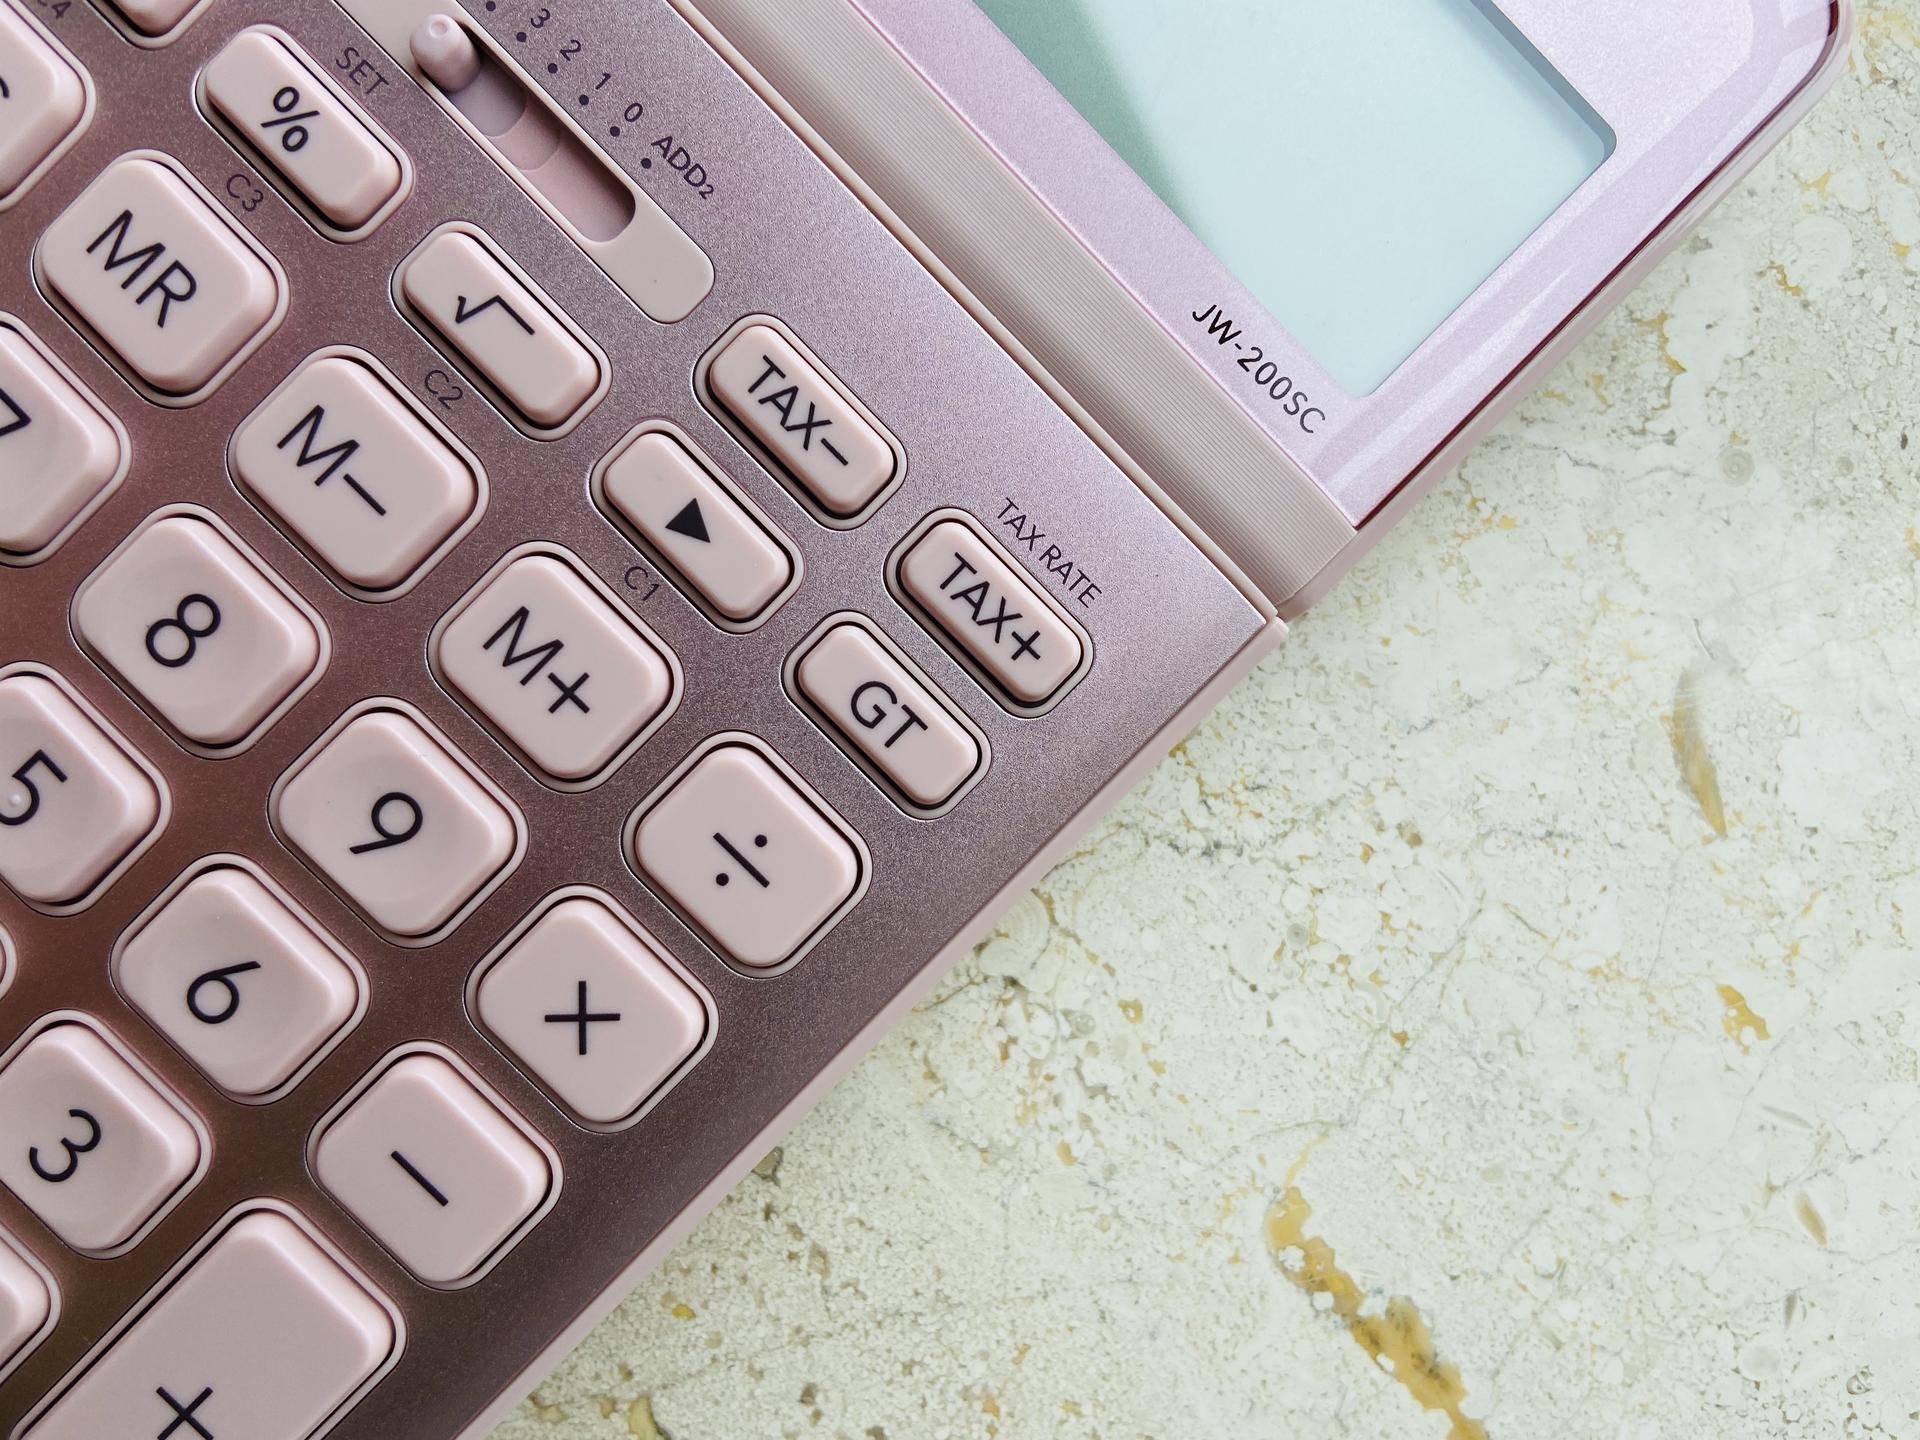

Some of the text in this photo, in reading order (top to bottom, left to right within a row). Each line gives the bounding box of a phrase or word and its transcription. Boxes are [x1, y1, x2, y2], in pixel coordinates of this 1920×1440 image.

[335, 47, 389, 95] SET
[530, 8, 551, 29] 3
[559, 39, 582, 61] 2
[595, 72, 612, 90] 1
[624, 102, 644, 123] 0
[260, 86, 320, 153] %
[226, 173, 264, 212] C3
[86, 209, 197, 329] MR
[424, 369, 464, 410] C2
[1192, 303, 1326, 434] JW-200SC
[624, 565, 660, 601] C1
[997, 497, 1103, 609] TAX RATE
[145, 593, 222, 668] 8
[939, 552, 1042, 661] TAX+
[482, 605, 591, 714] M+
[850, 680, 929, 748] GT
[0, 749, 68, 826] 5
[349, 791, 424, 855] 9
[186, 960, 262, 1025] 6
[29, 1108, 101, 1183] 3
